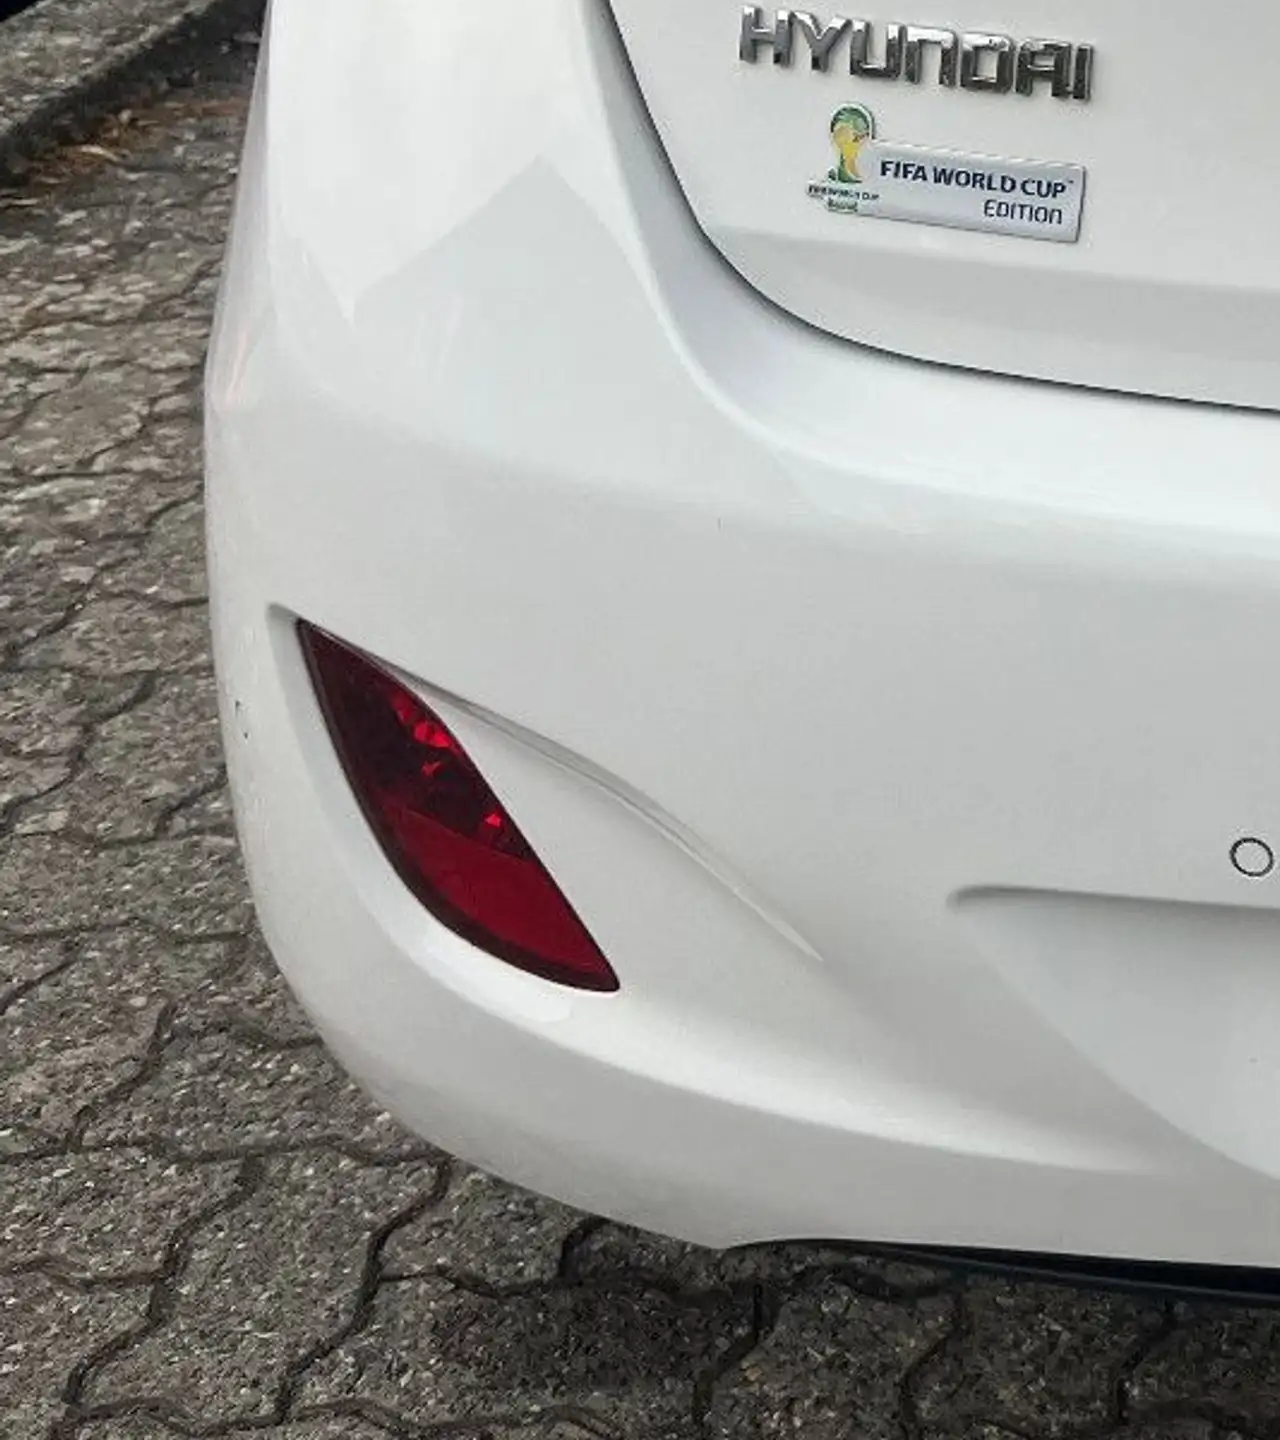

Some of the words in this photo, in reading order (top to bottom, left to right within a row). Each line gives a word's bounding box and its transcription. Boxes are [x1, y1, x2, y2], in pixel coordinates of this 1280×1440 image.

[739, 3, 1096, 101] HYUNDAI
[880, 160, 928, 182] FIFA
[933, 166, 1017, 194] WORLD
[984, 199, 1063, 225] EDITION
